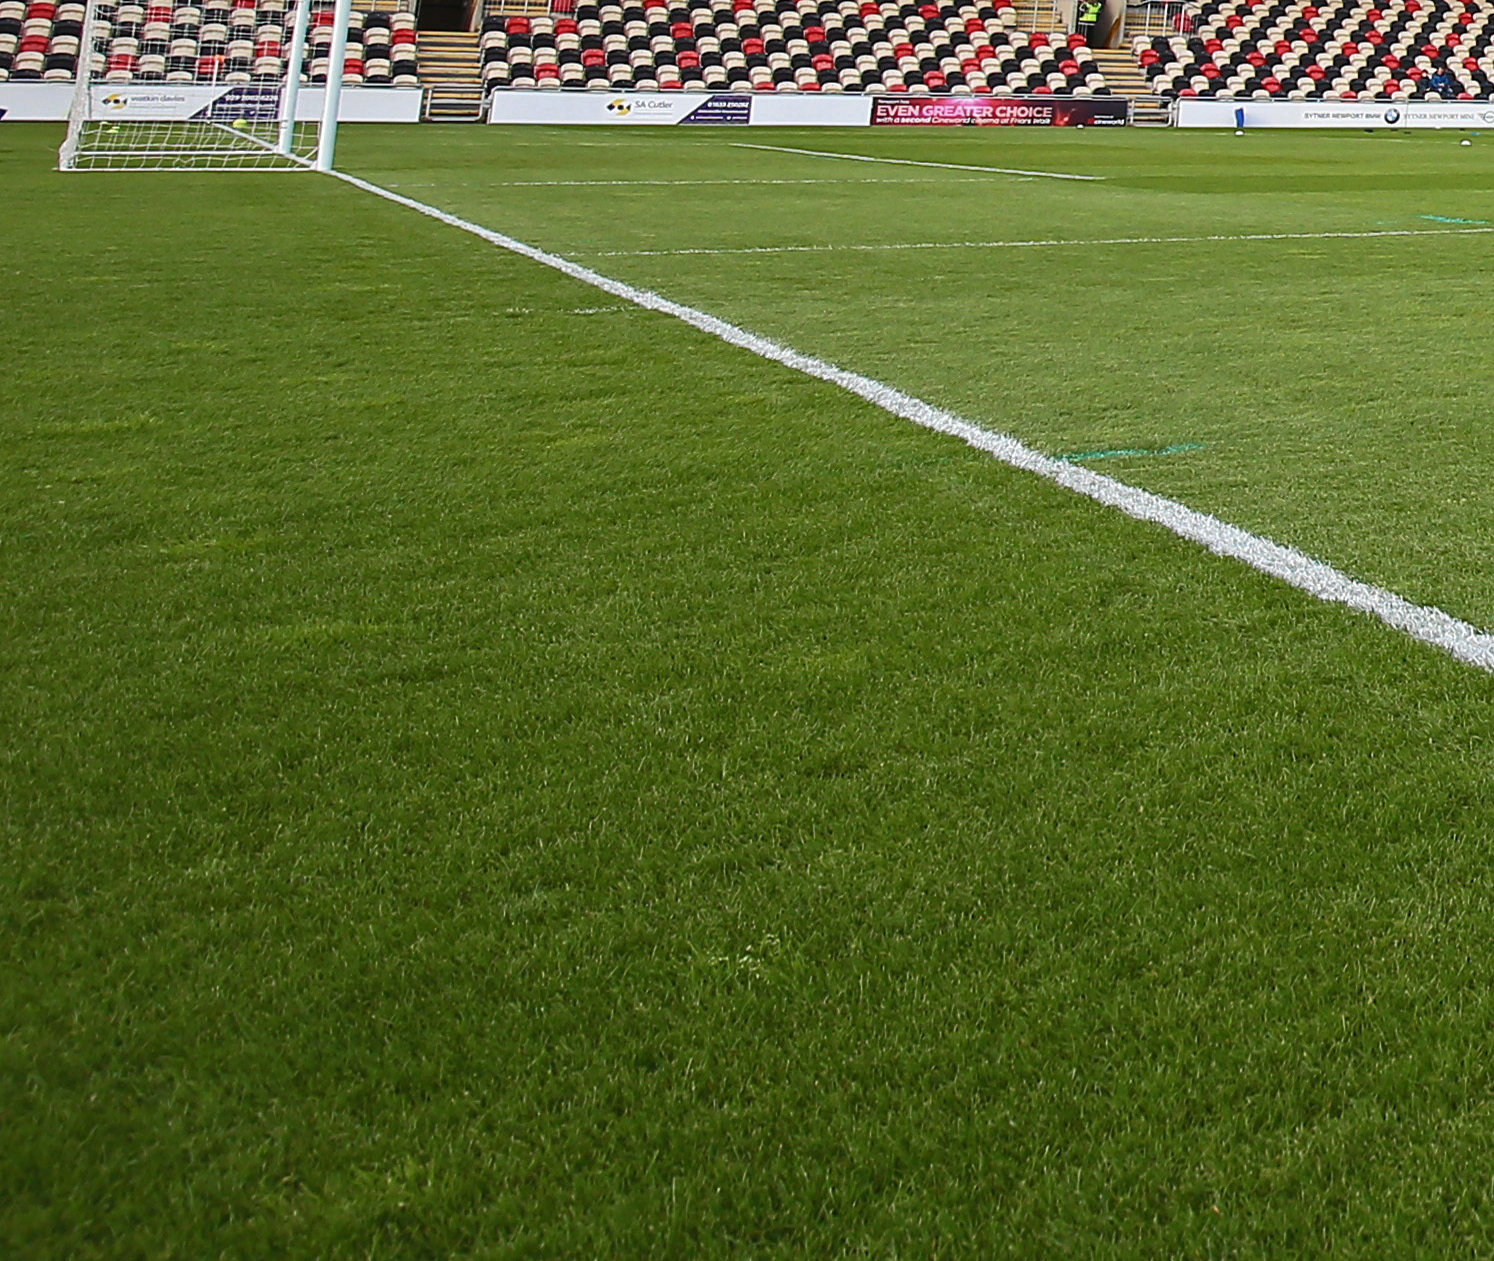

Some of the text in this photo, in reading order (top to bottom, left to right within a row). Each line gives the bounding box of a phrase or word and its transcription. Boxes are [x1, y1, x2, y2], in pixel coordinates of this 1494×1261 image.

[634, 100, 673, 109] SA Cutler
[876, 105, 1053, 118] EVEN GREATER CHOICE
